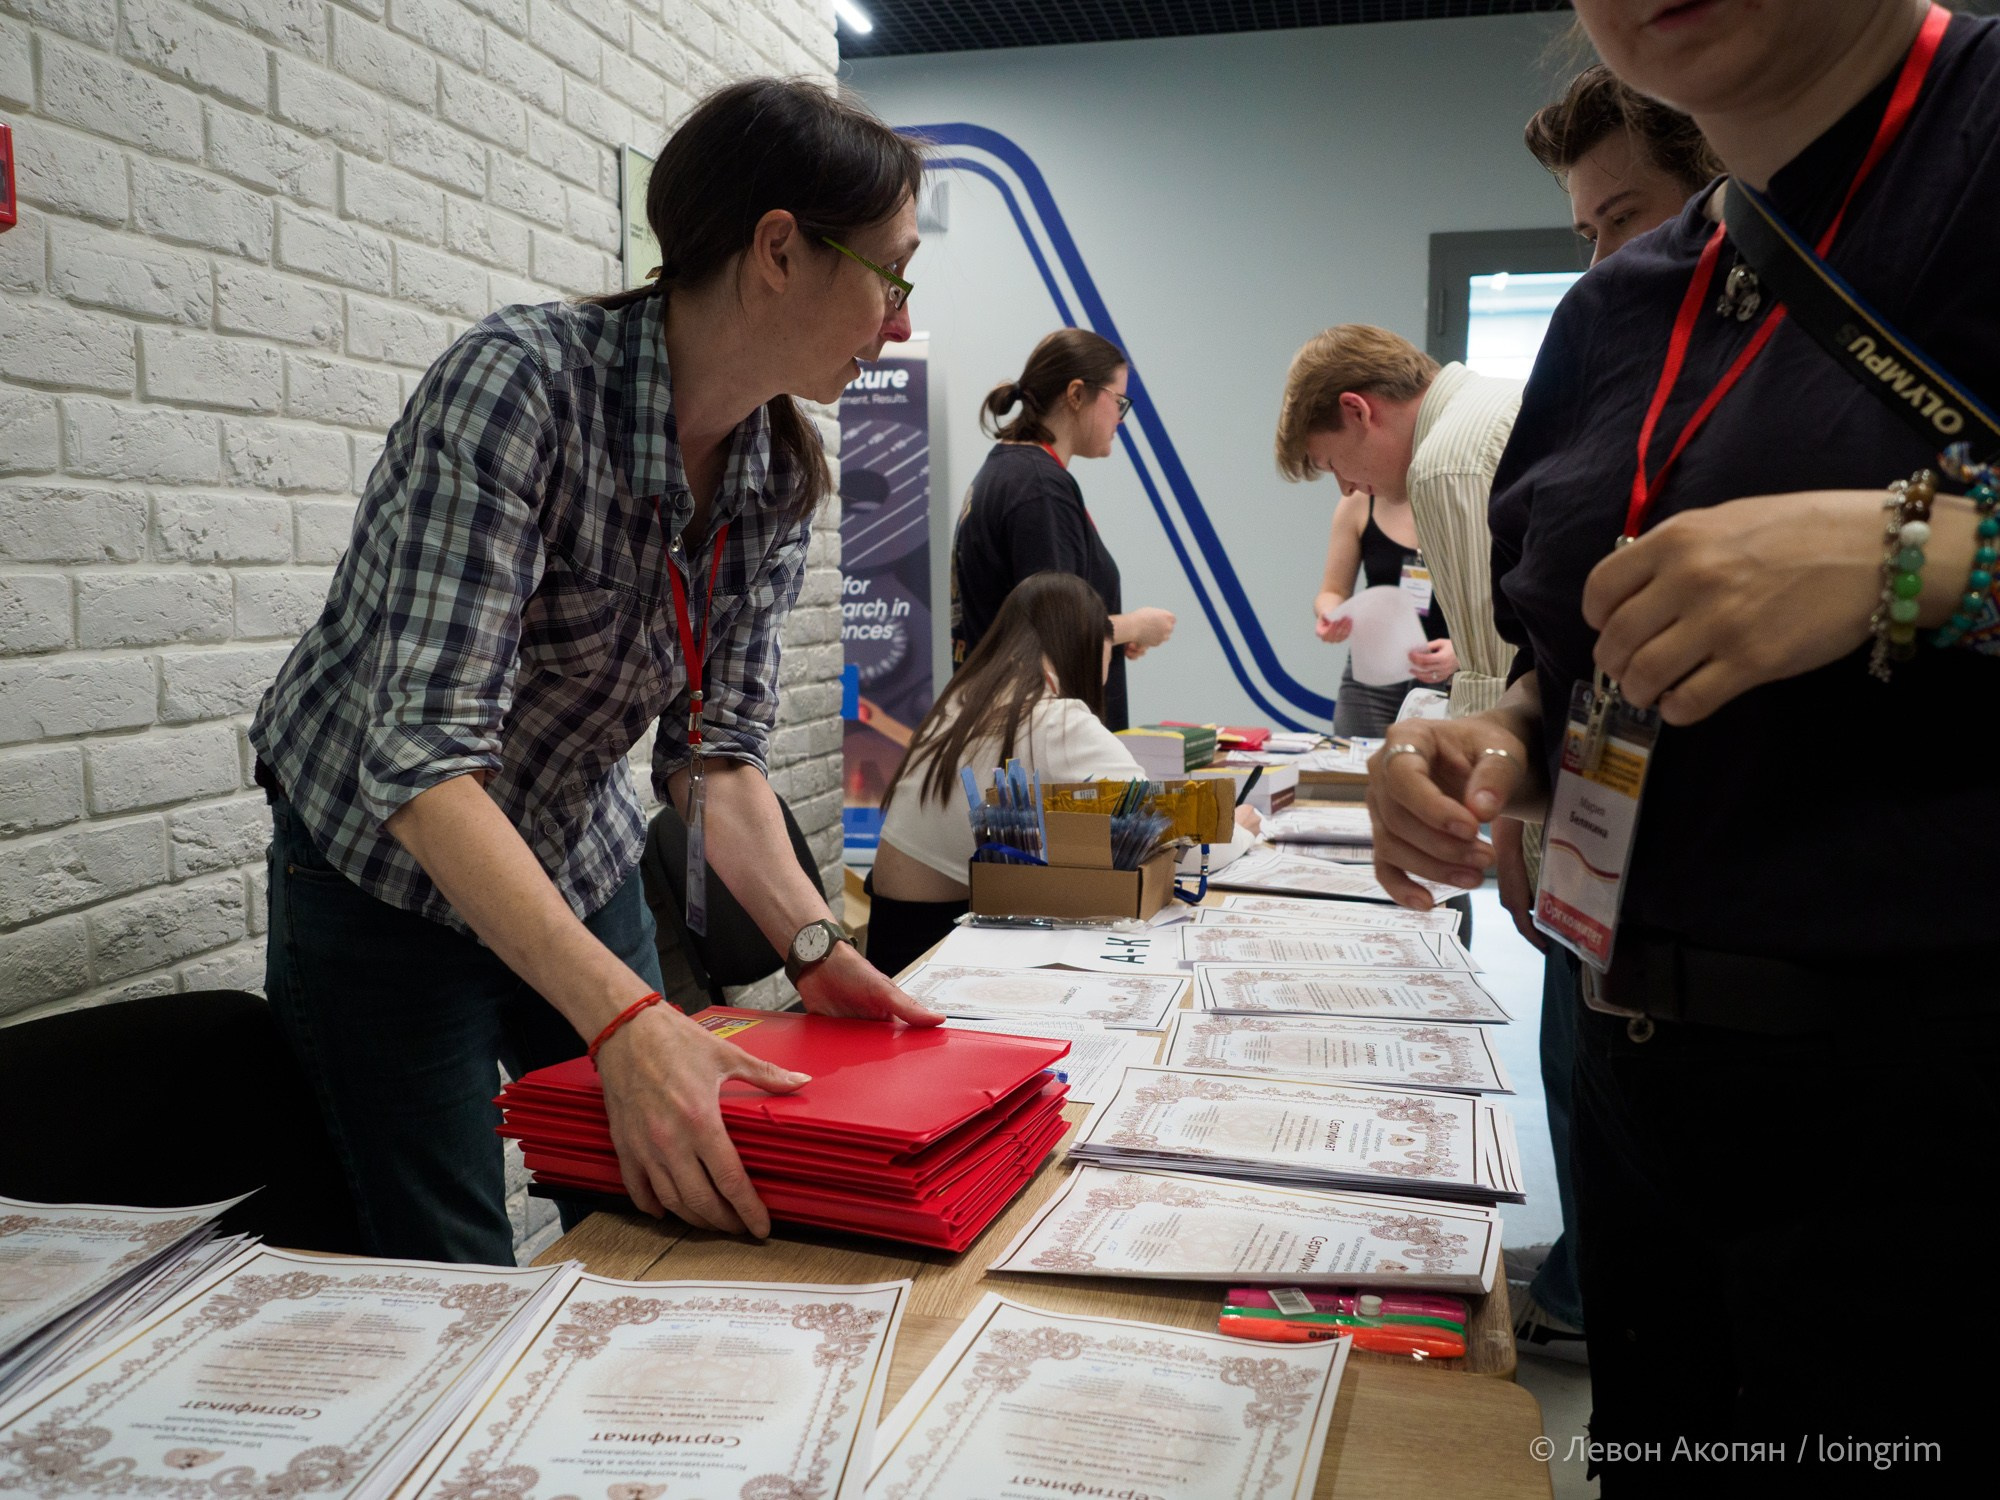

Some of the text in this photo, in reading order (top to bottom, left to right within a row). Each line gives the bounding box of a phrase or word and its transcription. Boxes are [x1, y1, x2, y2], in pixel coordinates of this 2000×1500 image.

[1839, 327, 1965, 435] OLYMPU
[842, 575, 871, 595] for
[891, 597, 911, 616] in
[1543, 899, 1604, 946] Оргкомитет
[1324, 1119, 1345, 1151] Сертификат
[179, 1400, 322, 1421] Сертификат
[588, 1431, 741, 1449] Сертификат
[582, 1467, 678, 1479] конференция
[660, 1459, 747, 1472] Когнитивная
